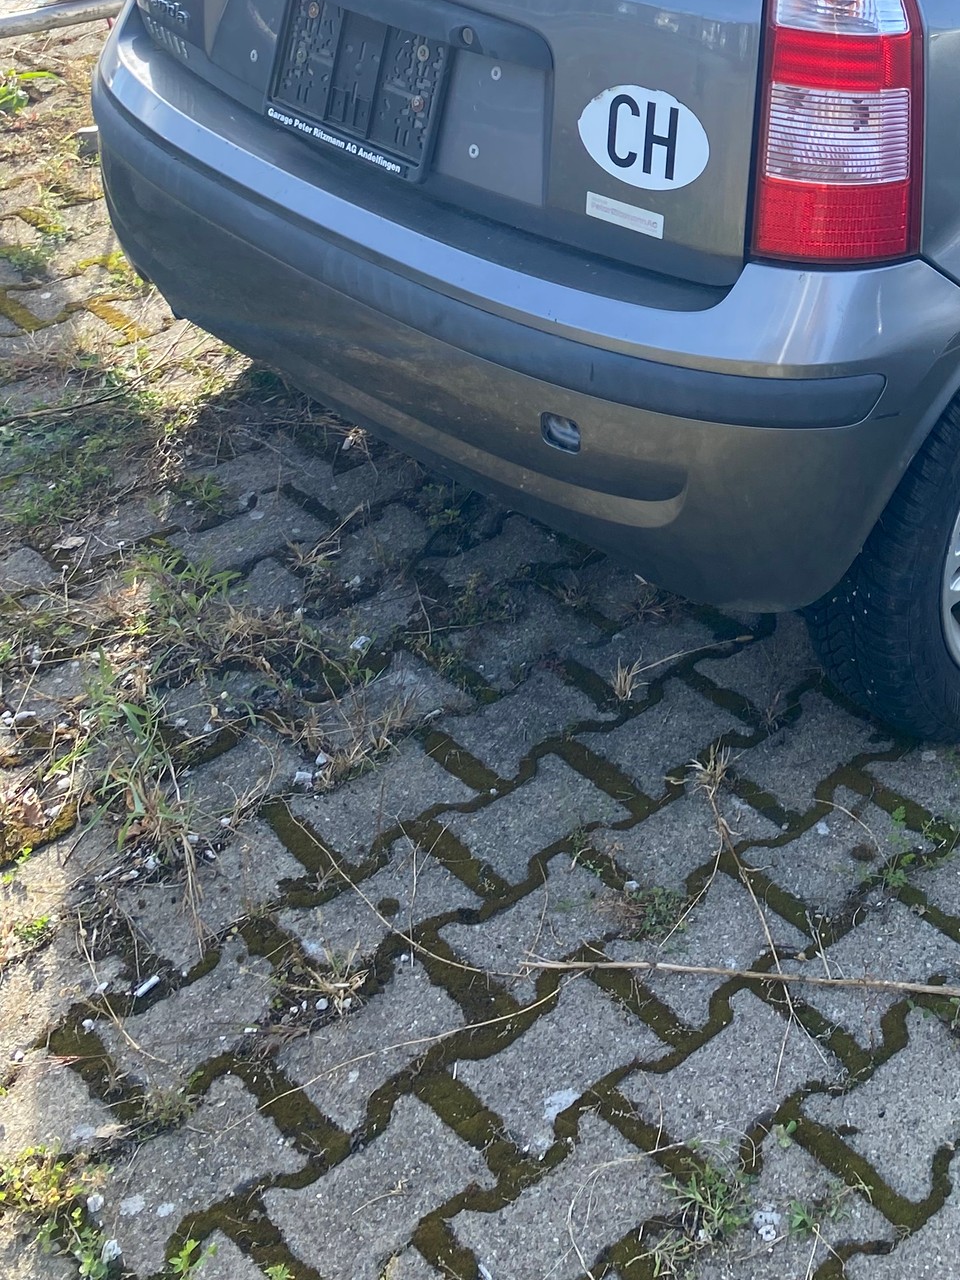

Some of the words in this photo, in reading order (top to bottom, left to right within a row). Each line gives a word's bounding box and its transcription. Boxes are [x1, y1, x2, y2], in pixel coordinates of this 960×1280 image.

[267, 107, 293, 126] Garage
[293, 118, 313, 134] Peter
[313, 127, 345, 149] Ritzmann
[345, 142, 357, 154] AG
[357, 147, 401, 173] Andelfingen
[606, 93, 680, 181] CH
